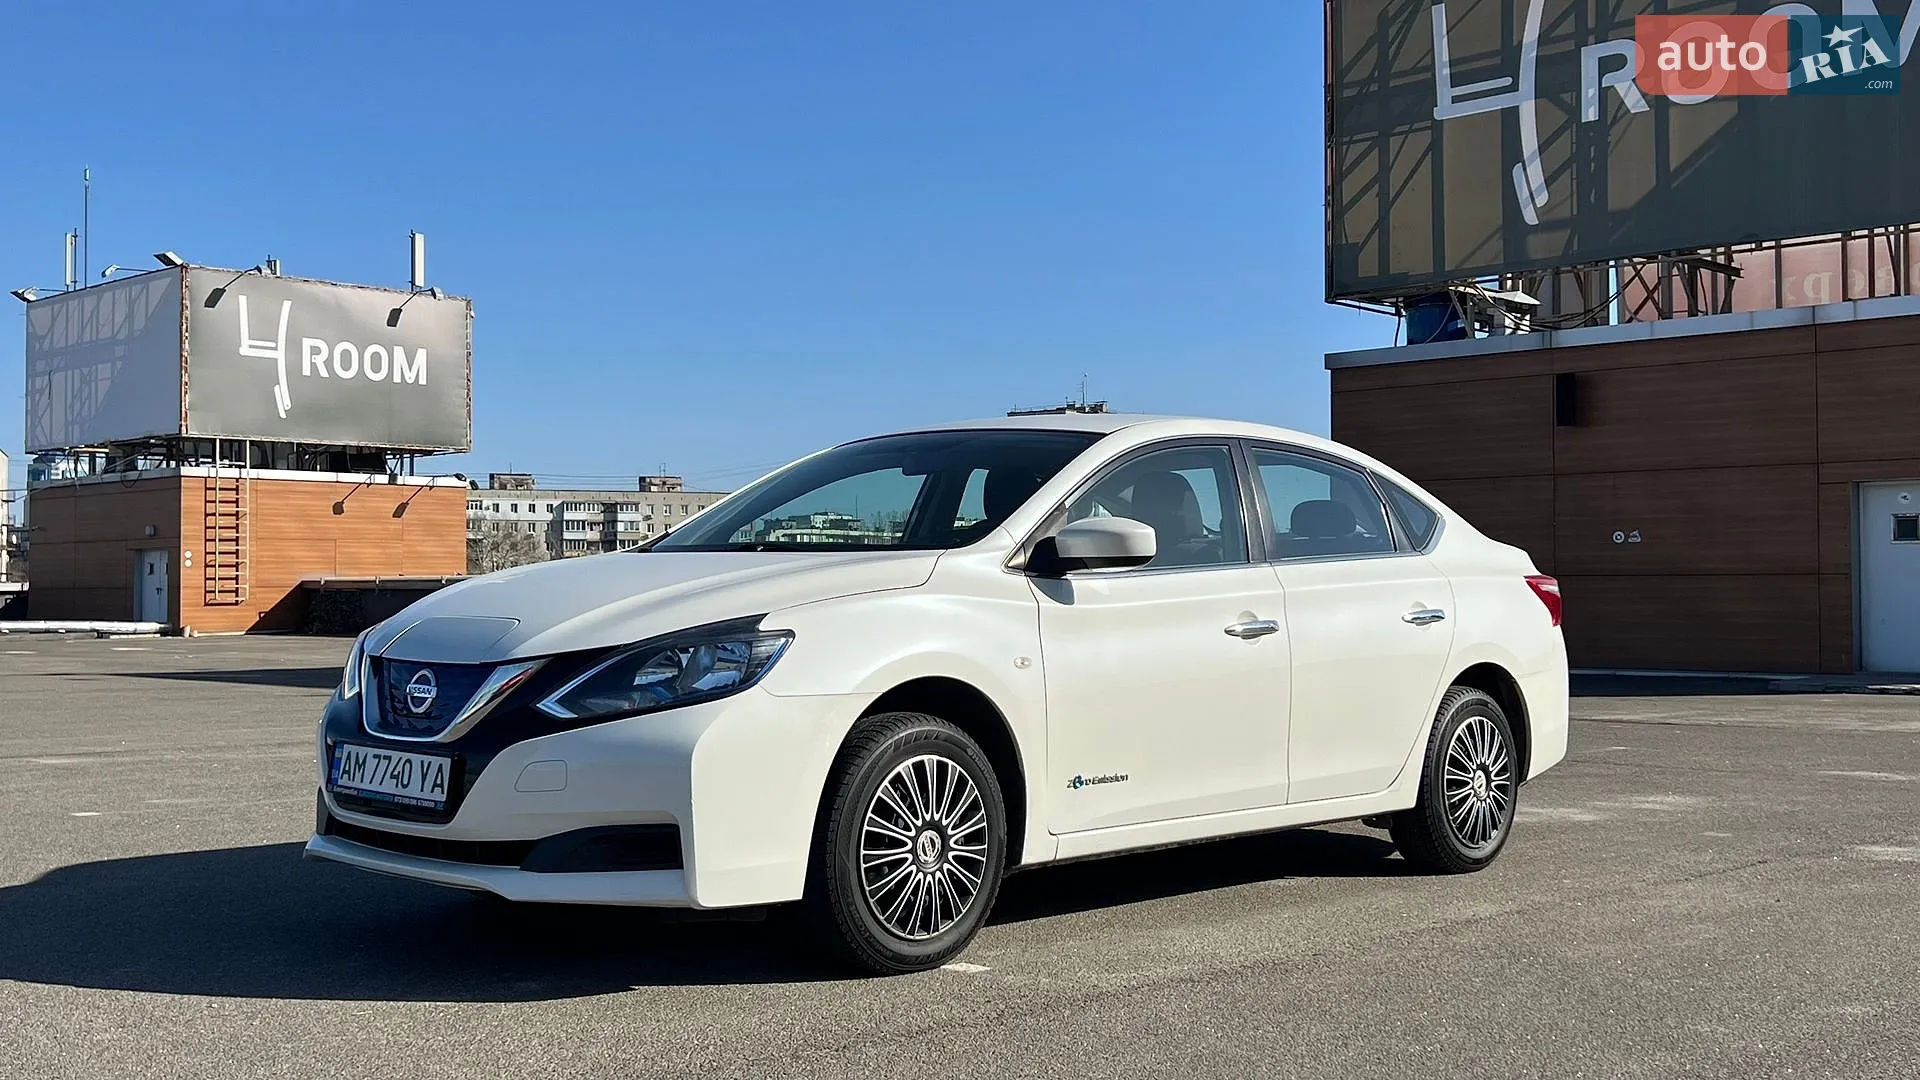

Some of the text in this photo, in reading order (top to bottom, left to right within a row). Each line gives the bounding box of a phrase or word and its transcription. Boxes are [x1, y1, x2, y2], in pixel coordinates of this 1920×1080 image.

[302, 337, 427, 385] ROOM
[340, 750, 445, 795] AM 7740 YA
